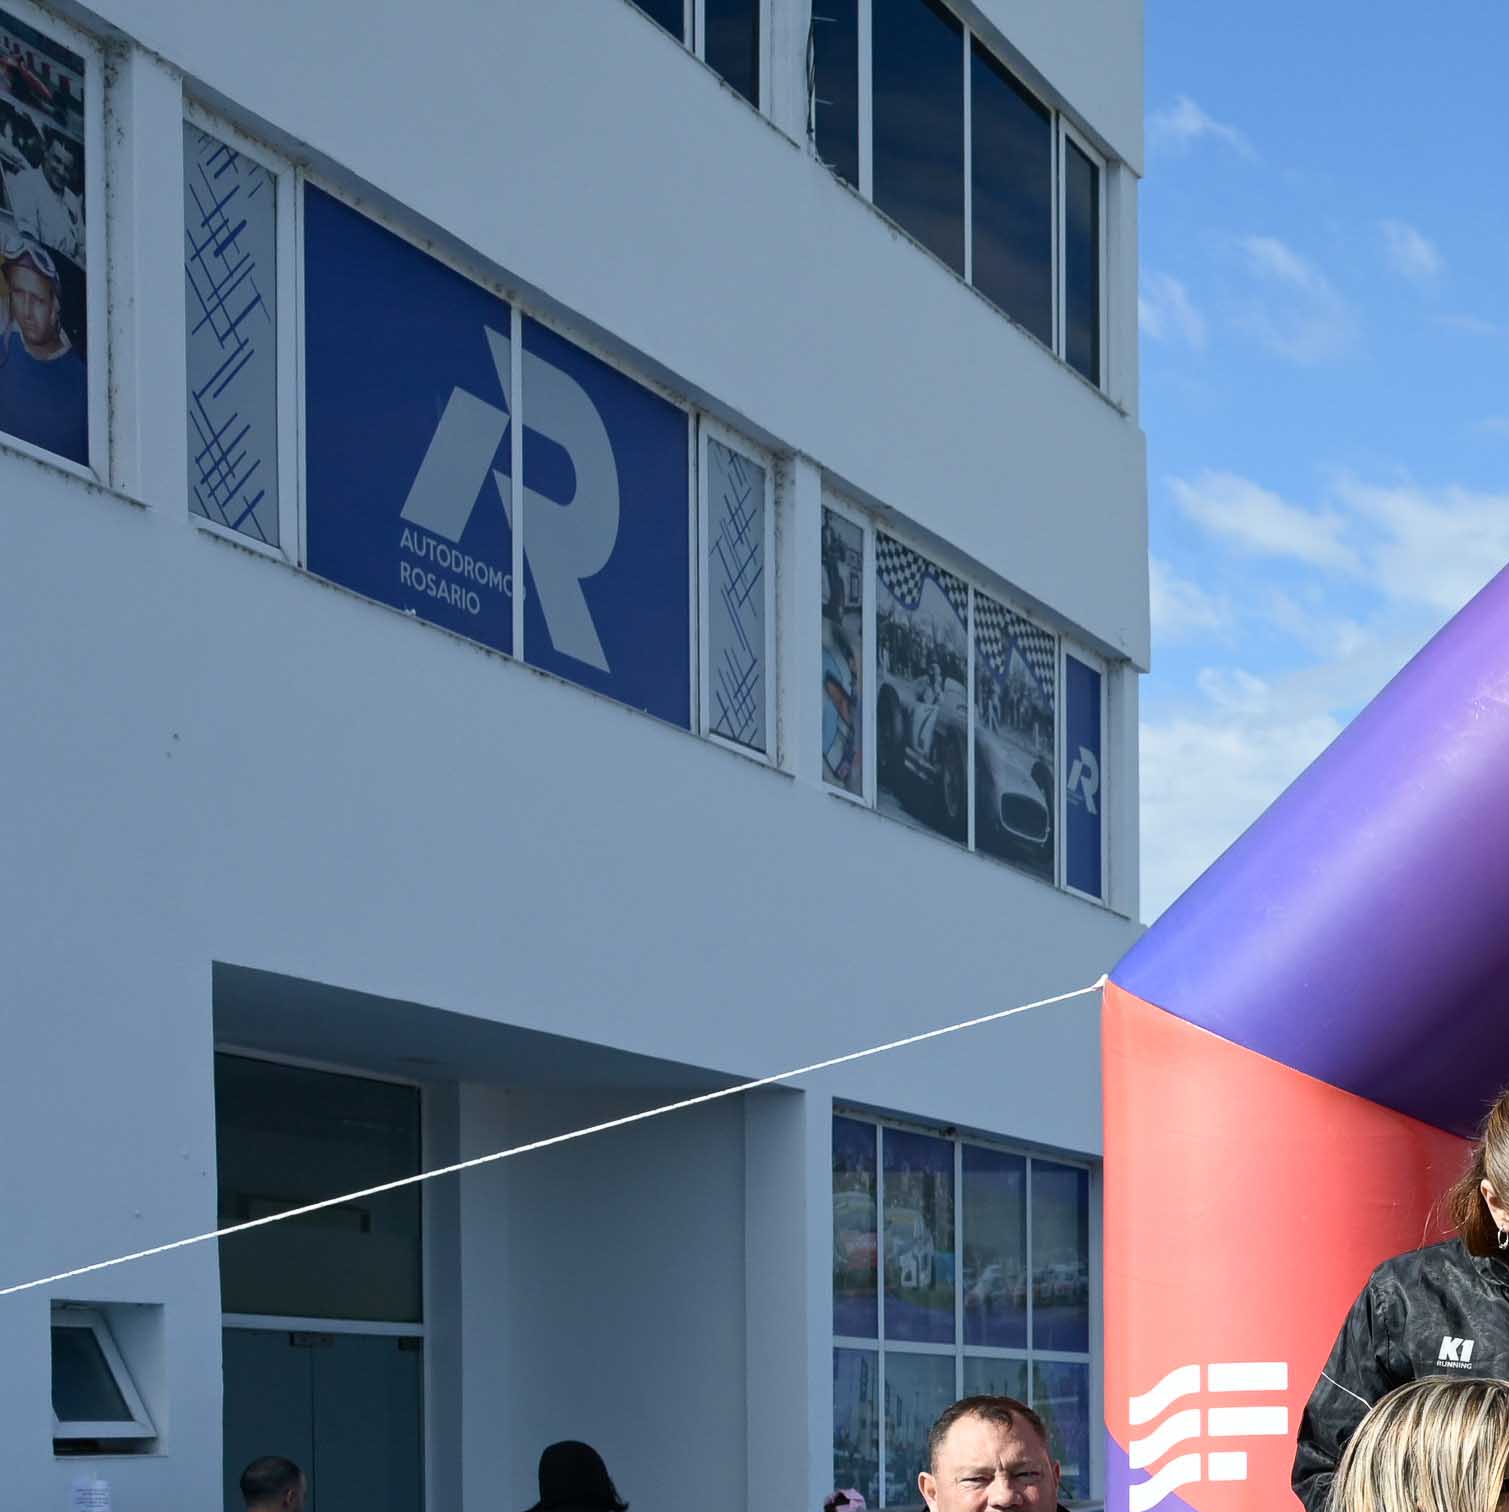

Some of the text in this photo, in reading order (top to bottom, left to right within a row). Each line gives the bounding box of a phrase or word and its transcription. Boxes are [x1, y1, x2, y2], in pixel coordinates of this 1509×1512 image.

[400, 527, 526, 600] AUTODROMO
[400, 560, 481, 615] ROSARIO
[1437, 1361, 1473, 1370] RUNNING
[1438, 1336, 1475, 1362] K1
